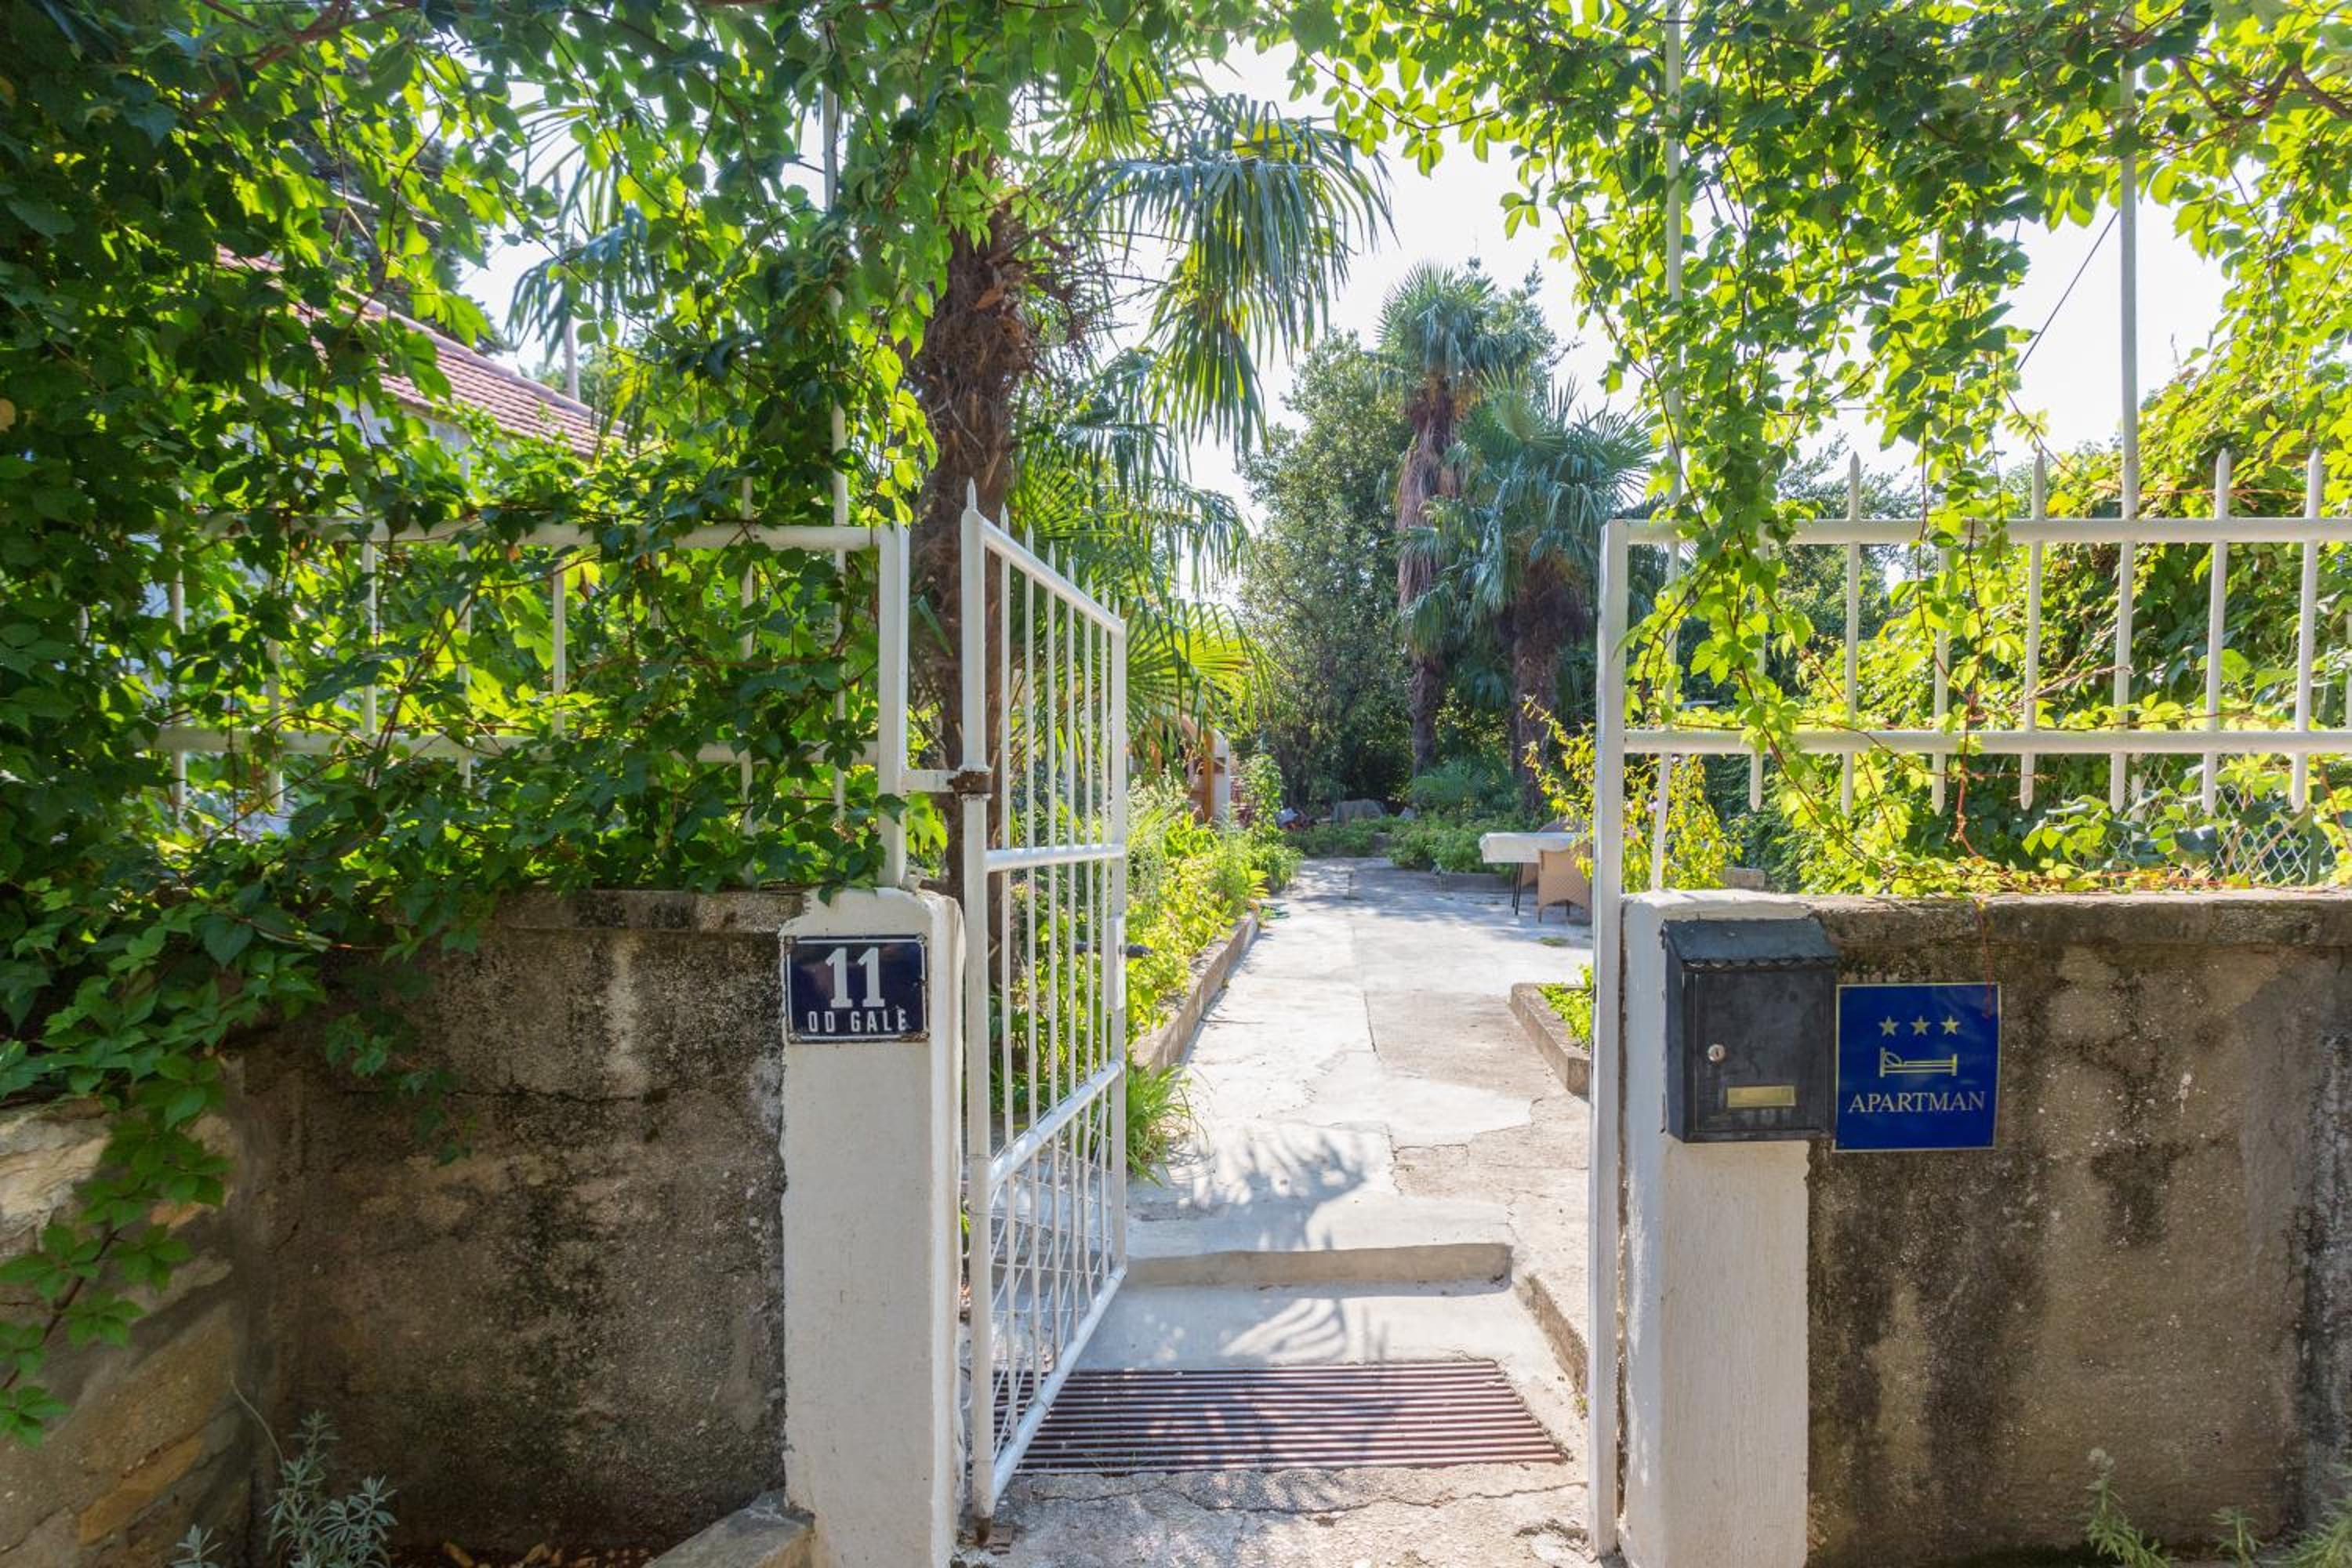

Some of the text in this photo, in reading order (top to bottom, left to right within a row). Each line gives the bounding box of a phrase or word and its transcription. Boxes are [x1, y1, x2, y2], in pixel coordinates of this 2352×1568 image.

[825, 947, 884, 1007] 11
[808, 1009, 906, 1033] OD GALE
[1848, 1091, 1985, 1112] APARTMAN
